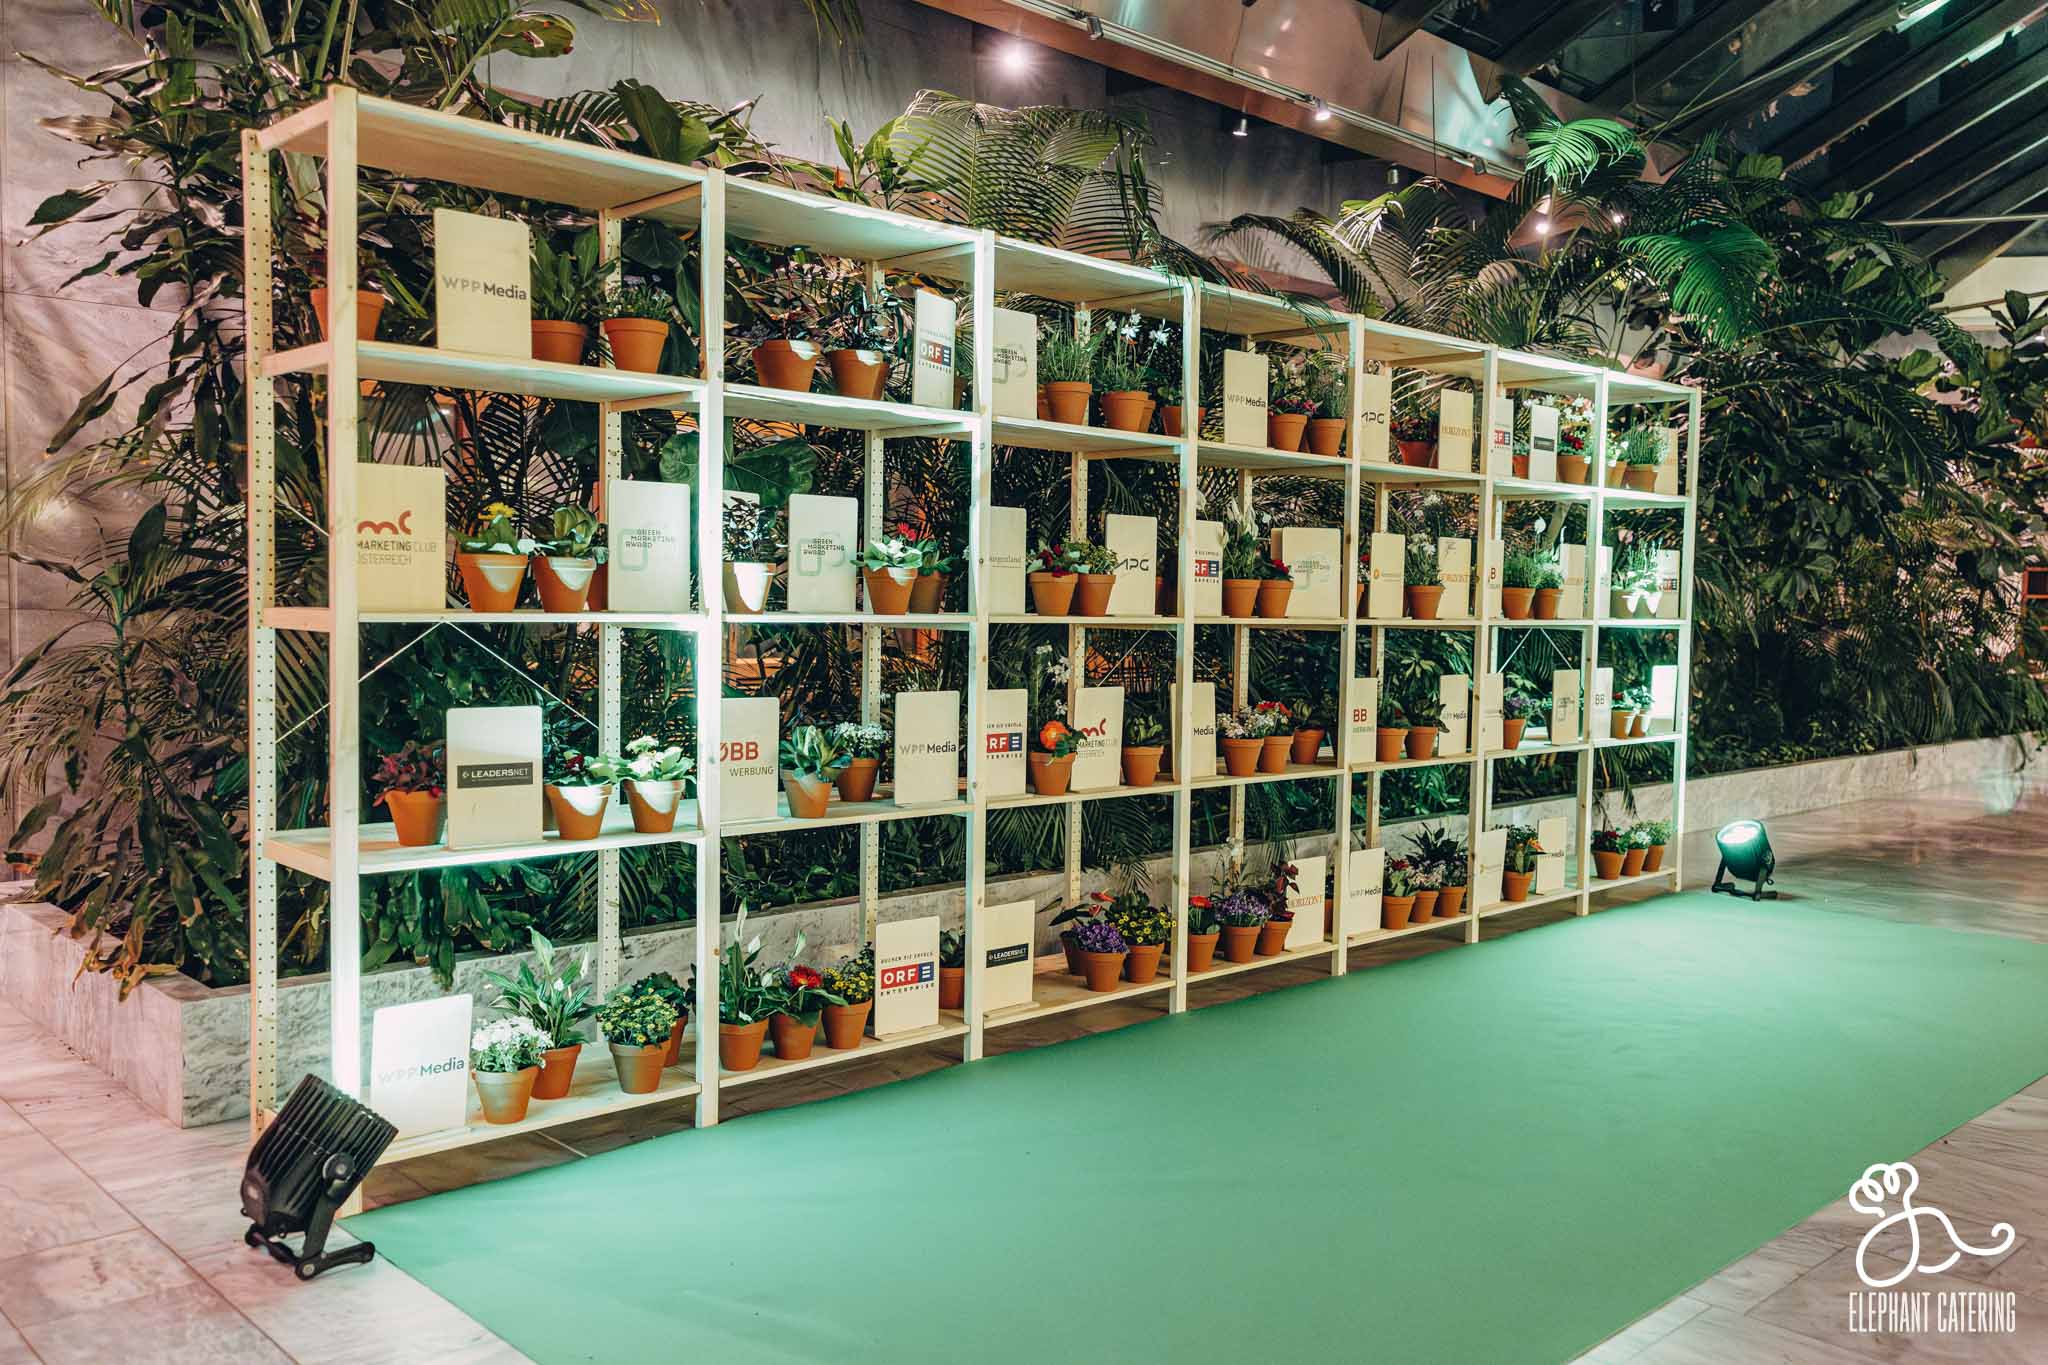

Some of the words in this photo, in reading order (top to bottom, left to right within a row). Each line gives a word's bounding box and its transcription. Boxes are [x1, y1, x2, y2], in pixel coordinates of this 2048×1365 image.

[441, 274, 480, 293] WPP
[483, 283, 527, 301] Media
[1353, 708, 1368, 722] BB
[926, 740, 956, 753] Media
[471, 767, 529, 779] LEADERSNET
[729, 765, 775, 777] WERBUNG
[419, 1056, 465, 1077] Media
